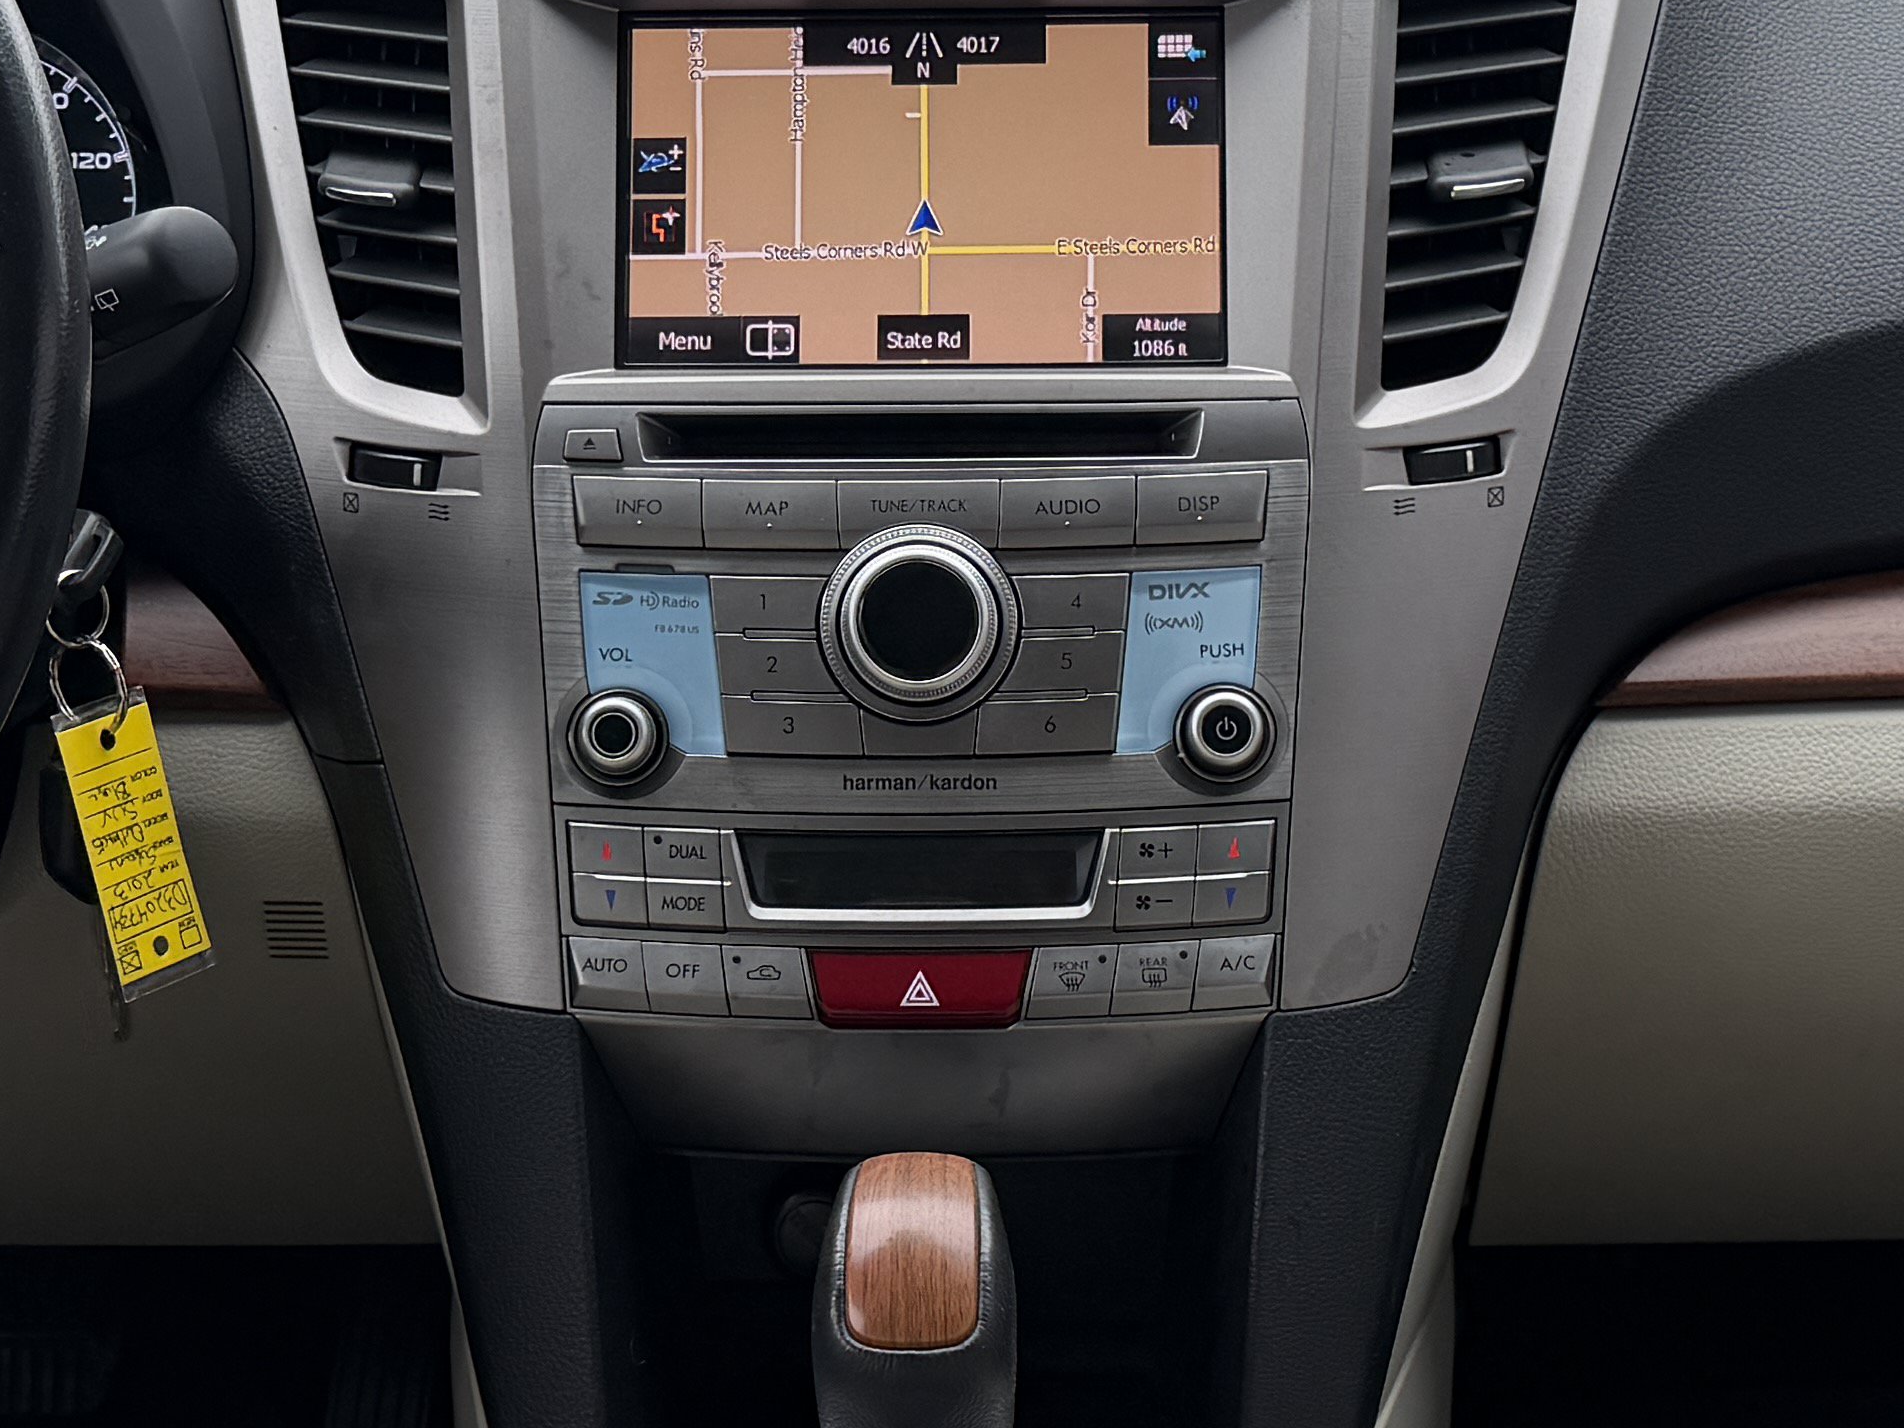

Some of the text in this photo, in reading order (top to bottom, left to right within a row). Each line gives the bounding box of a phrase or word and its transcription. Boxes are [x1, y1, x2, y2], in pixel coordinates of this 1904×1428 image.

[847, 37, 890, 55] 4016
[956, 36, 999, 54] 4017
[689, 58, 705, 81] Rd
[916, 63, 930, 78] N
[789, 67, 807, 142] Hampton
[71, 152, 111, 169] 120
[764, 241, 928, 260] Steels Corners Rd W
[1057, 237, 1216, 255] E Steels Corners Rd
[1081, 287, 1096, 308] Dr
[1135, 317, 1187, 332] Altitude
[658, 332, 712, 351] Menu
[886, 331, 961, 349] State Rd
[1132, 339, 1175, 357] 1086
[615, 498, 663, 516] INFO
[745, 500, 789, 517] MAP
[870, 498, 967, 514] TUNE/TRACK
[1035, 498, 1101, 515] AUDIO
[1179, 495, 1220, 512] DISP
[662, 595, 700, 609] Radio
[760, 594, 767, 610] 1
[1071, 593, 1082, 609] 4
[598, 647, 633, 662] VOL
[1199, 643, 1245, 659] PUSH
[767, 656, 778, 673] 2
[1061, 653, 1073, 670] 5
[783, 716, 795, 734] 3
[1044, 715, 1056, 733] 6
[842, 773, 998, 791] harman/kardon
[669, 845, 707, 860] DUAL
[661, 896, 706, 912] MODE
[582, 957, 628, 974] AUTO
[1053, 959, 1089, 971] FRONT
[1139, 956, 1168, 967] REAR
[1220, 955, 1256, 971] A/C
[665, 963, 700, 979] OFF
